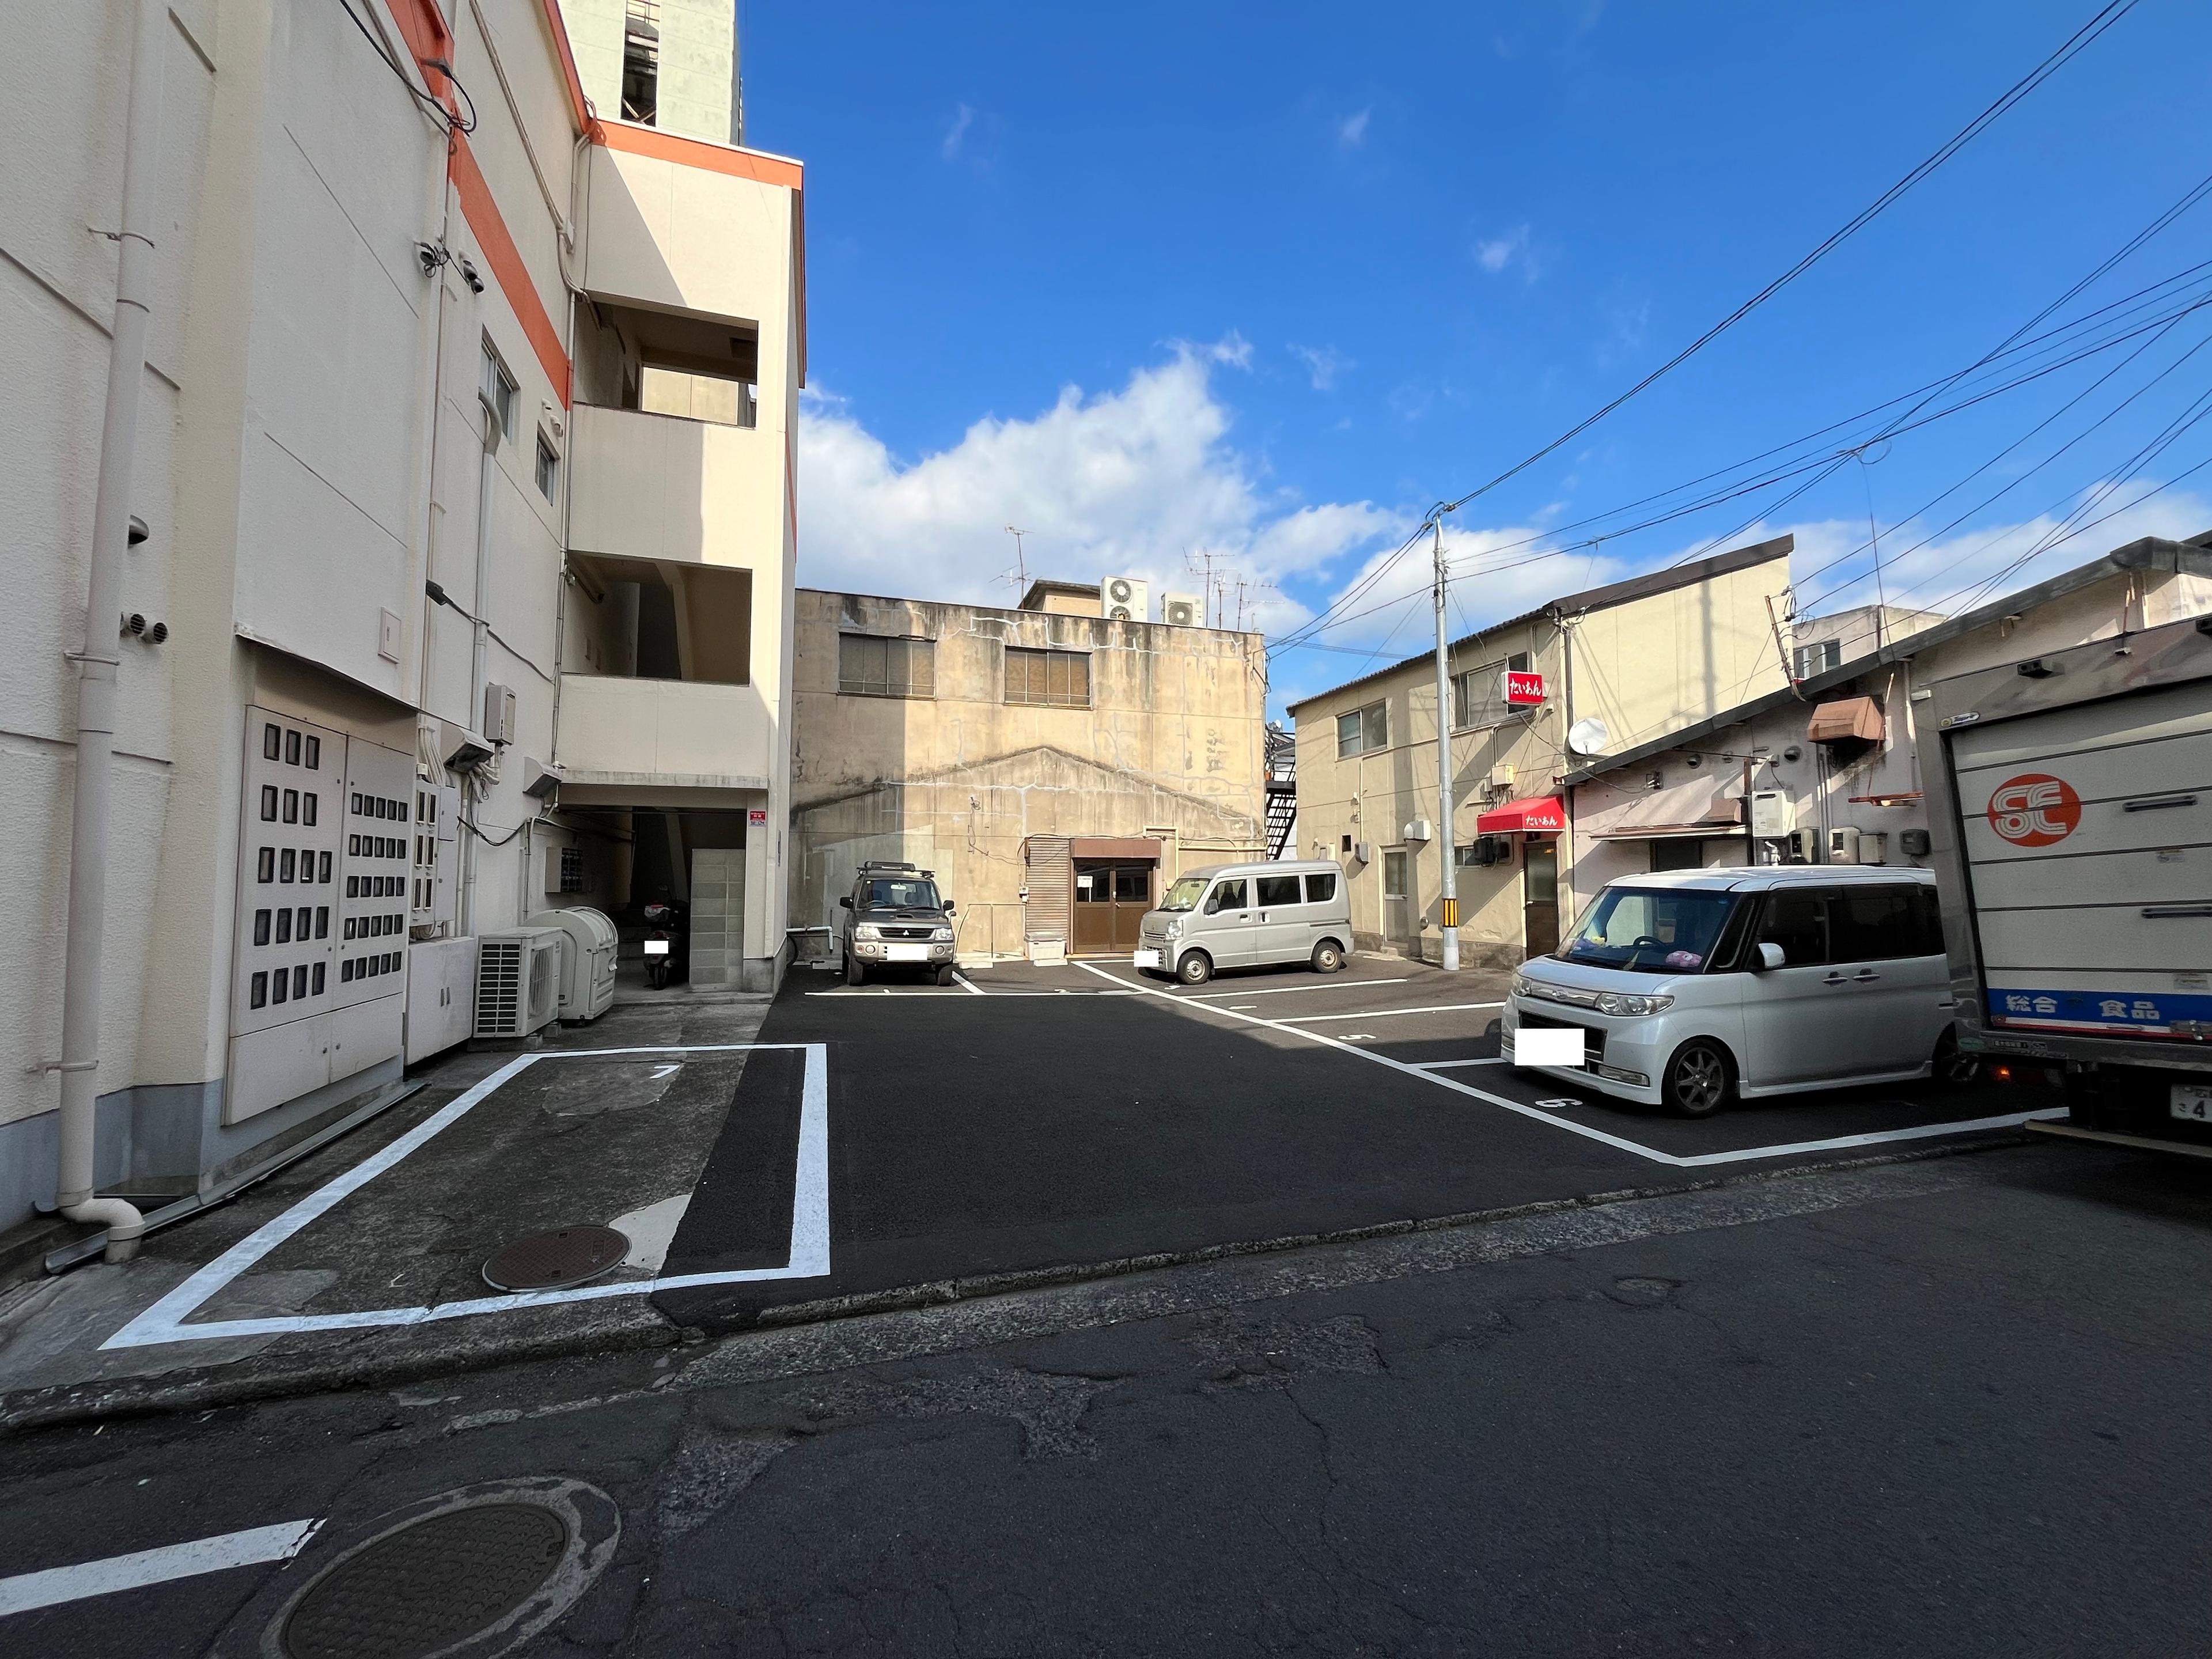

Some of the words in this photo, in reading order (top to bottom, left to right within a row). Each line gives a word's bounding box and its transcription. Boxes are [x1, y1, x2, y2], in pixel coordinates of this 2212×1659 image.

[1509, 677, 1542, 696] たいあん
[1525, 815, 1558, 826] たいあん
[2005, 994, 2058, 1013] 総合
[2099, 999, 2160, 1020] 食品
[649, 1065, 680, 1079] 7
